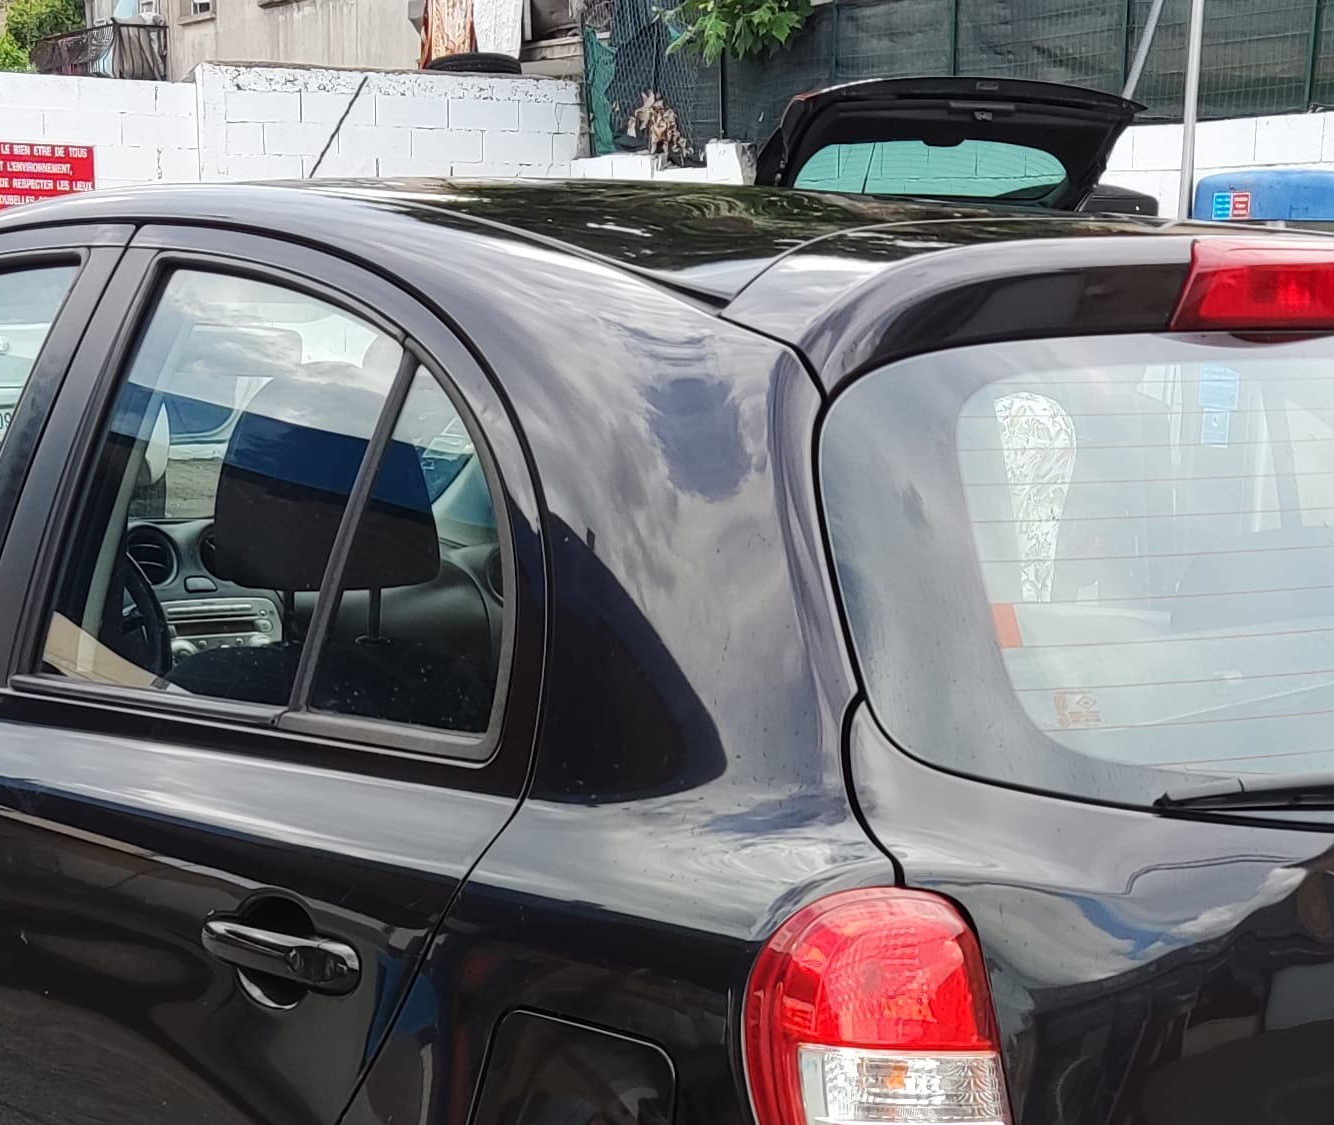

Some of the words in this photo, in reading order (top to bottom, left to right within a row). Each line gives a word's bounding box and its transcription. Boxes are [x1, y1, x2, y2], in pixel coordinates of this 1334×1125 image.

[1, 144, 10, 154] LE
[55, 147, 65, 157] DE
[69, 147, 88, 158] TOUS
[0, 178, 9, 188] DE
[13, 178, 54, 189] RESPECTER
[57, 180, 70, 190] LES
